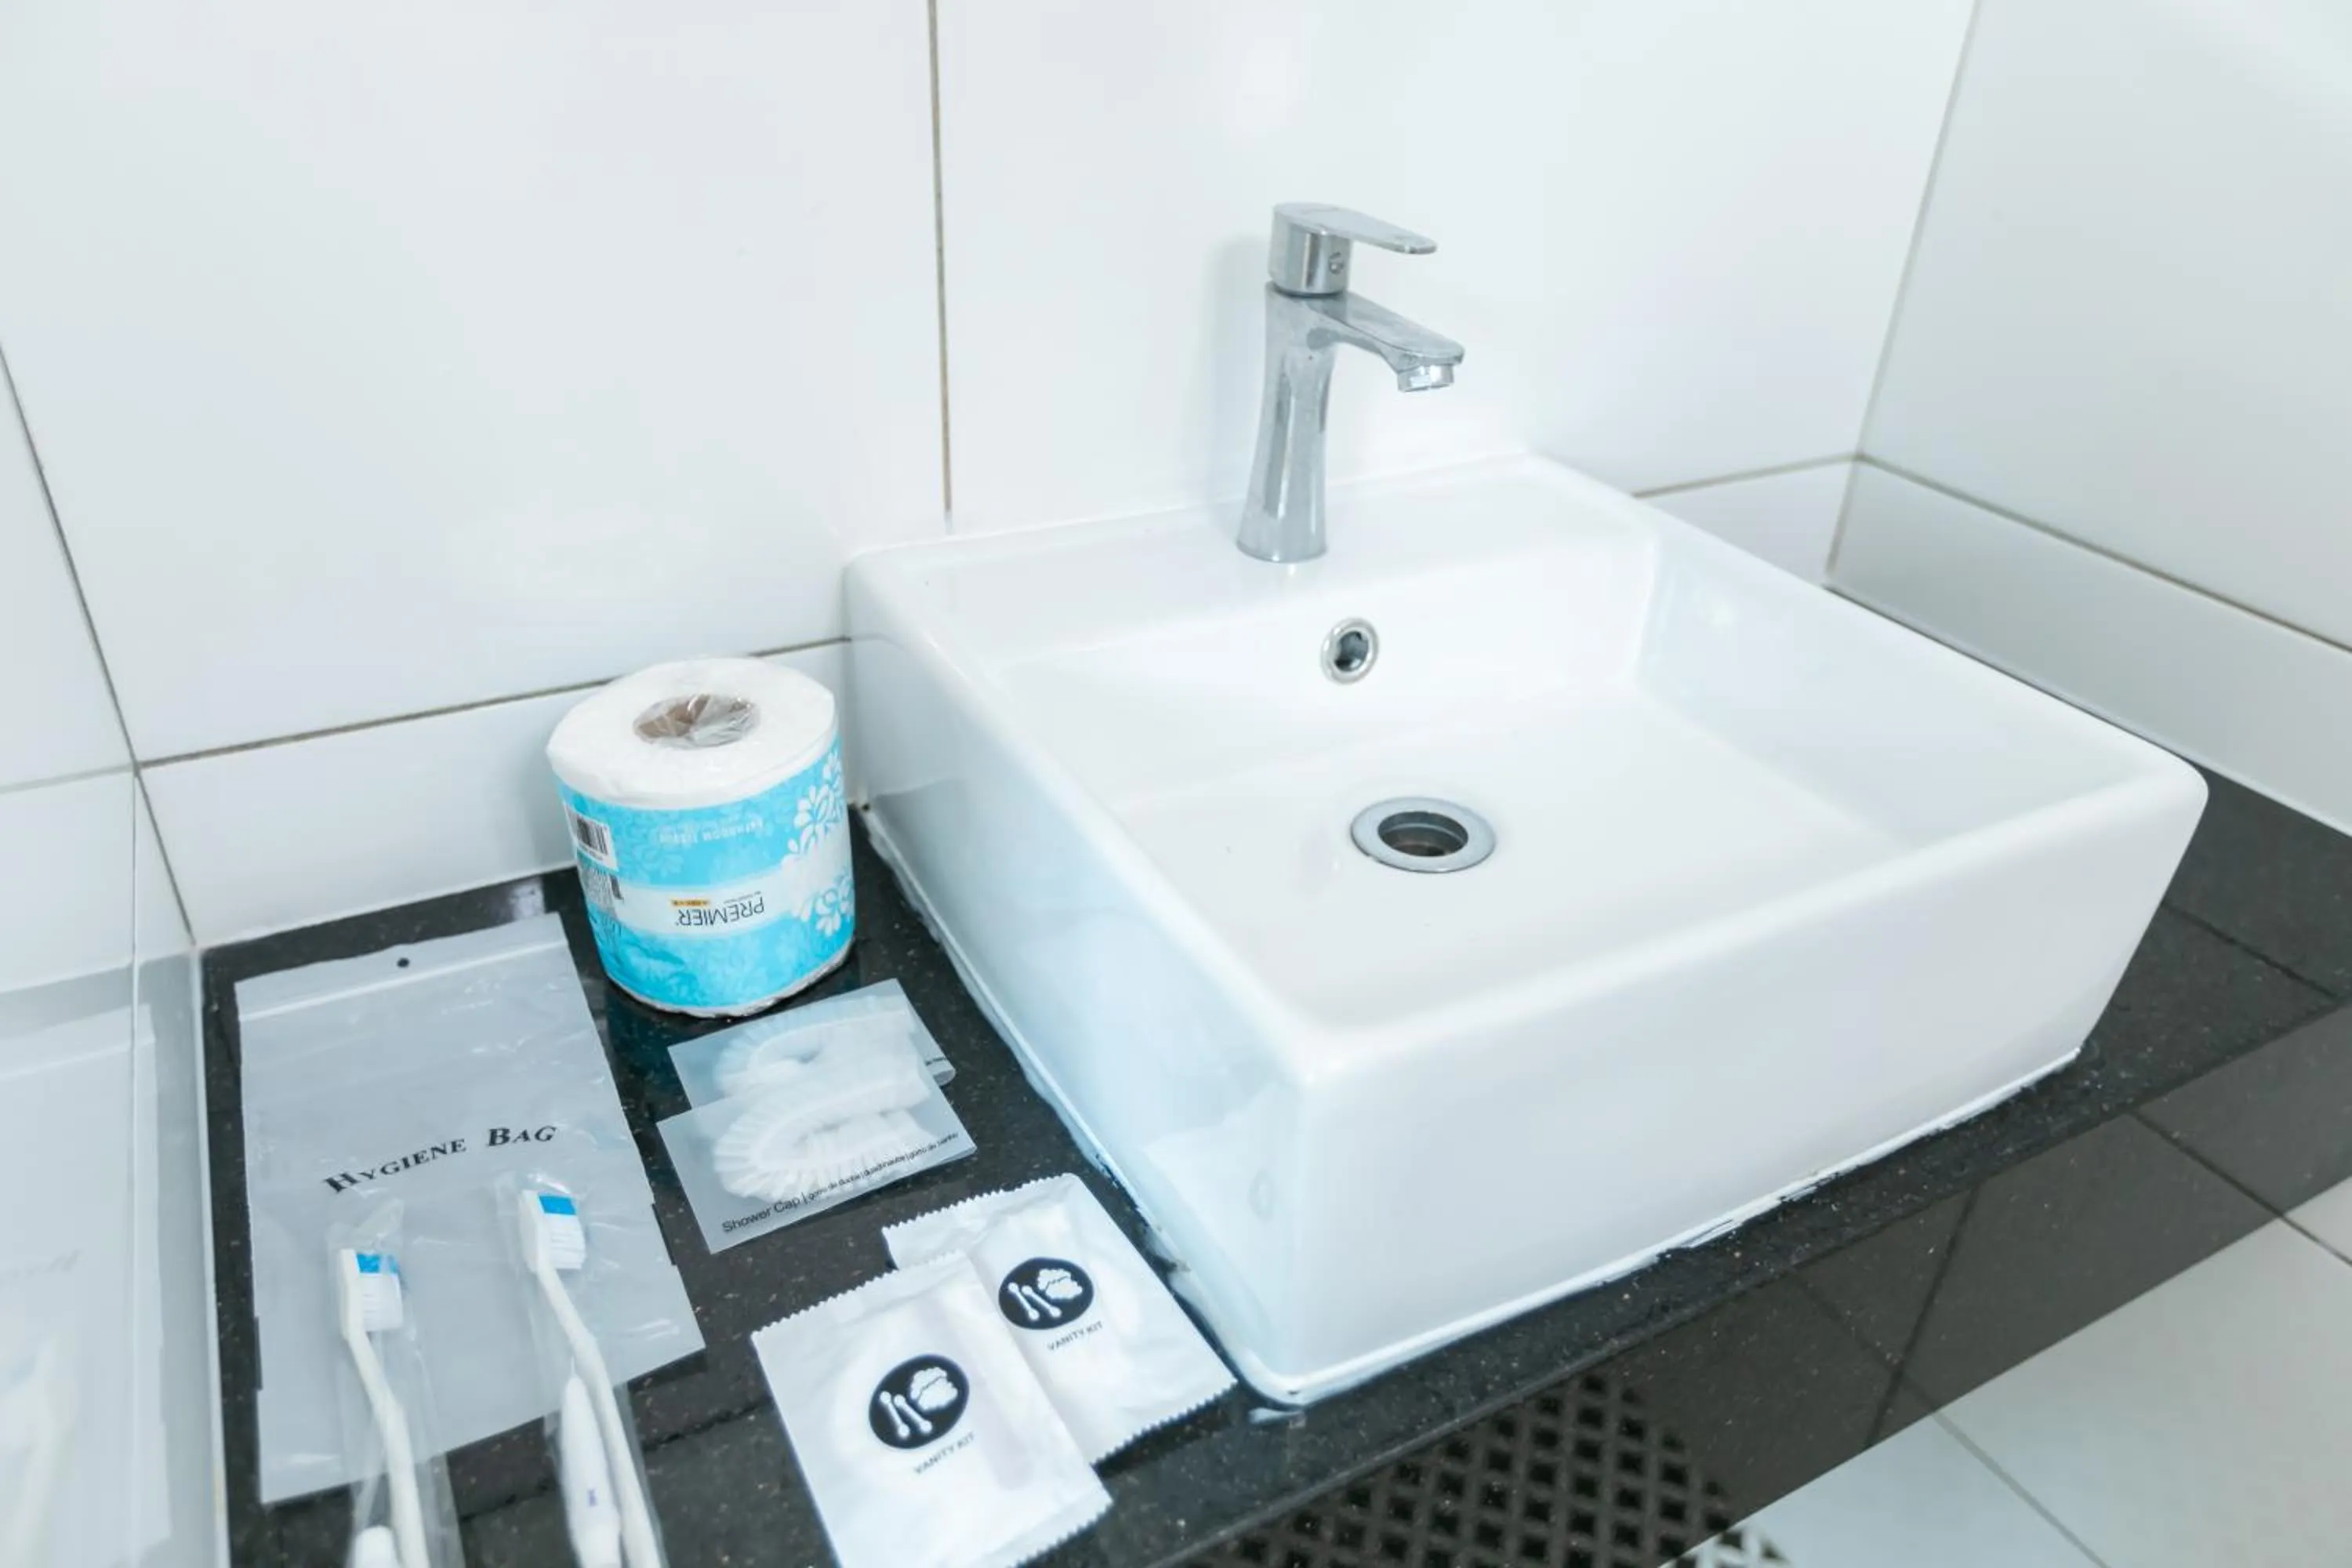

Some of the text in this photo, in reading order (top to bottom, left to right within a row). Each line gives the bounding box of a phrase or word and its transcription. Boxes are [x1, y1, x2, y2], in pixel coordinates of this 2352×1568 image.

[677, 896, 765, 926] PREMIER
[721, 1206, 772, 1233] Shower
[773, 1196, 801, 1214] Cap
[1048, 1320, 1104, 1350] VANITY KIT
[914, 1432, 975, 1474] VANITY KIT
